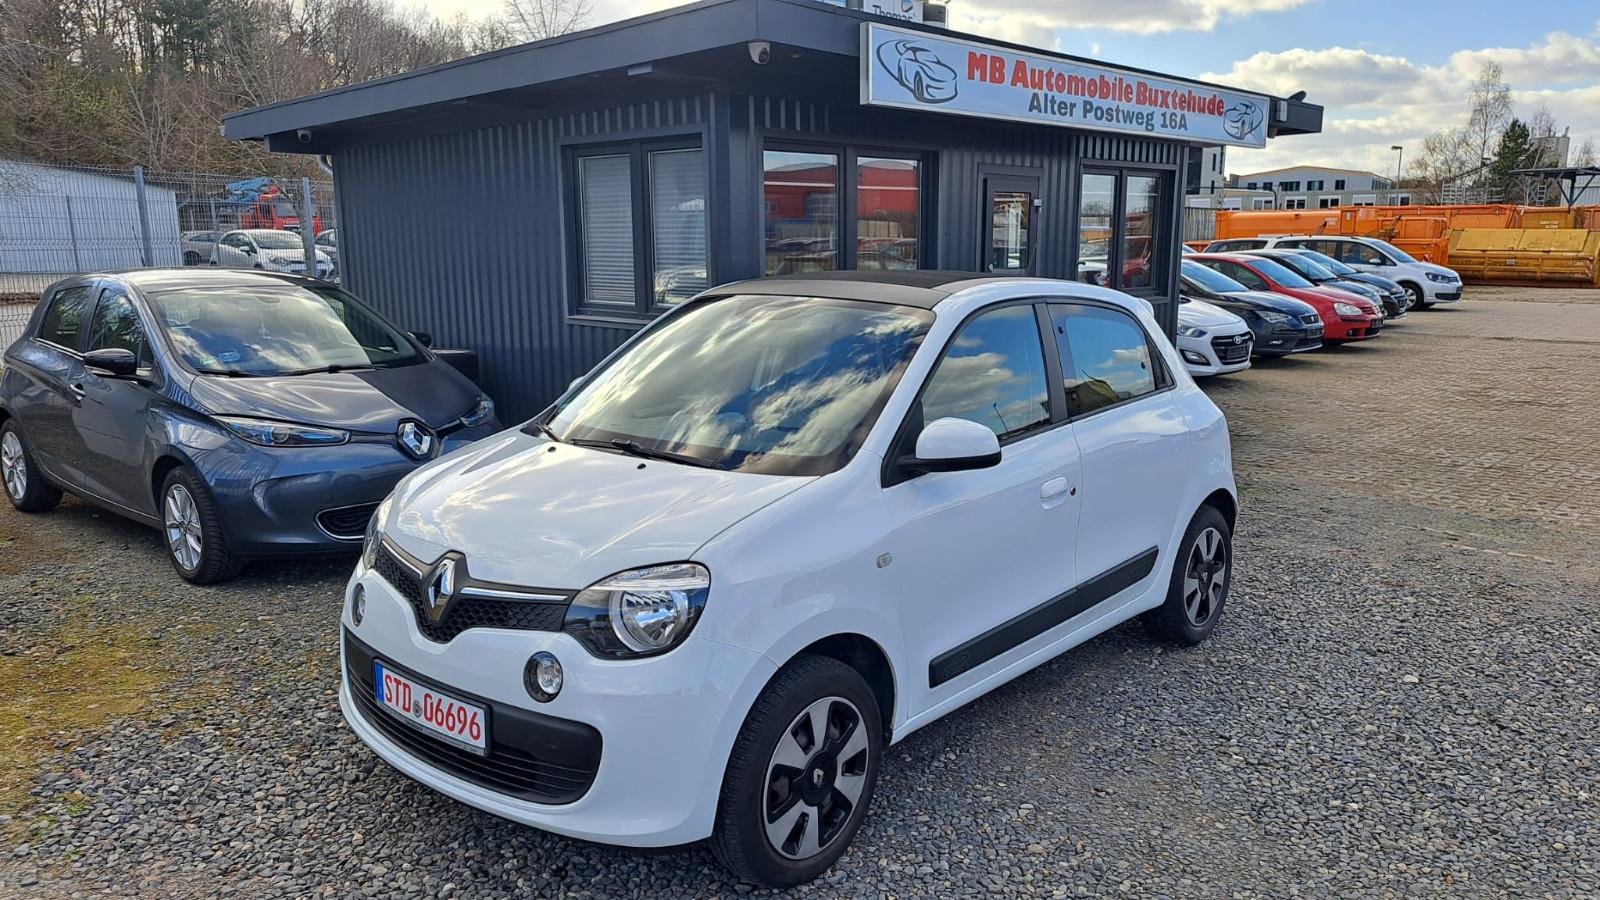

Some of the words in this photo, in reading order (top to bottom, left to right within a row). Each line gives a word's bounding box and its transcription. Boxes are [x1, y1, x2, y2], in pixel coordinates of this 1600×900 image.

[967, 51, 1006, 84] MB
[1010, 60, 1133, 103] Automobile
[1135, 81, 1224, 116] Buxtehude
[1028, 92, 1077, 117] Alter
[1082, 100, 1155, 131] Postweg
[1160, 111, 1188, 131] 16A
[384, 673, 412, 713] STD
[423, 692, 481, 741] 06696
